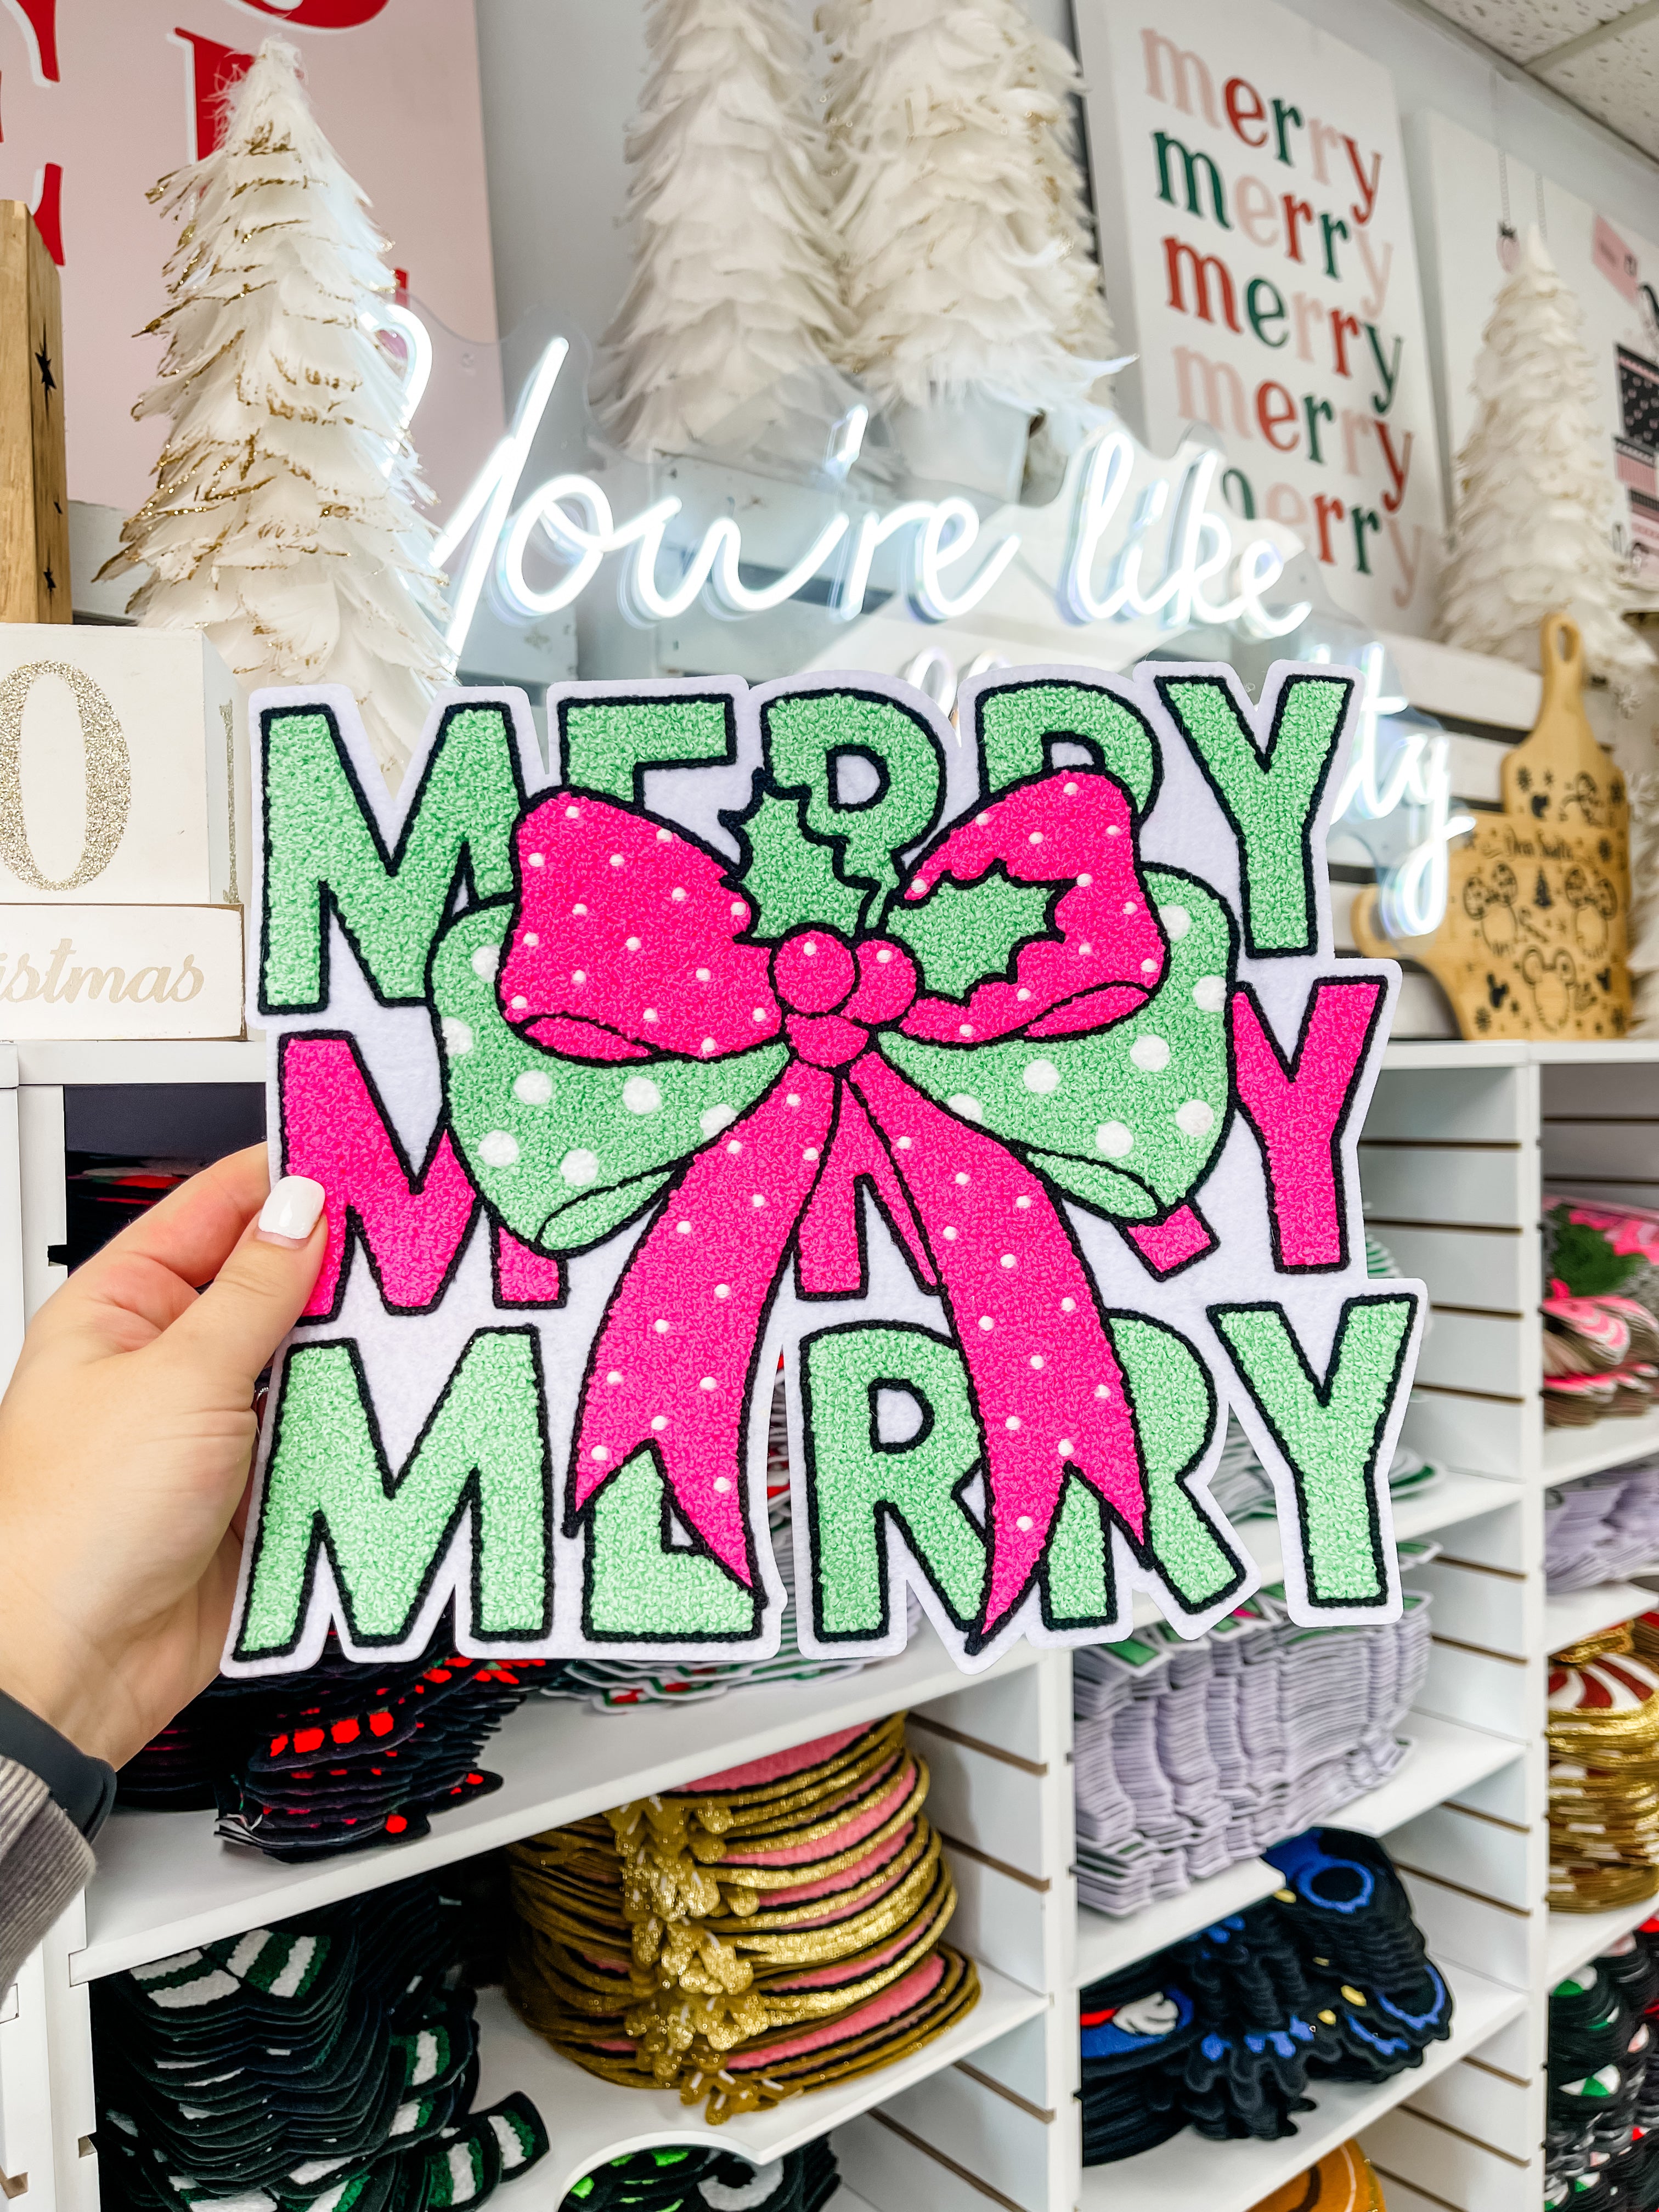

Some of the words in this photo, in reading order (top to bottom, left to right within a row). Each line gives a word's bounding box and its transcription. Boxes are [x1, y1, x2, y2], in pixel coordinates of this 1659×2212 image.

[1141, 27, 1383, 225] merry
[1150, 130, 1394, 319] merry
[1161, 235, 1404, 415] merry
[356, 303, 1021, 674] You're
[1063, 431, 1312, 638] like
[1171, 345, 1414, 514] merry
